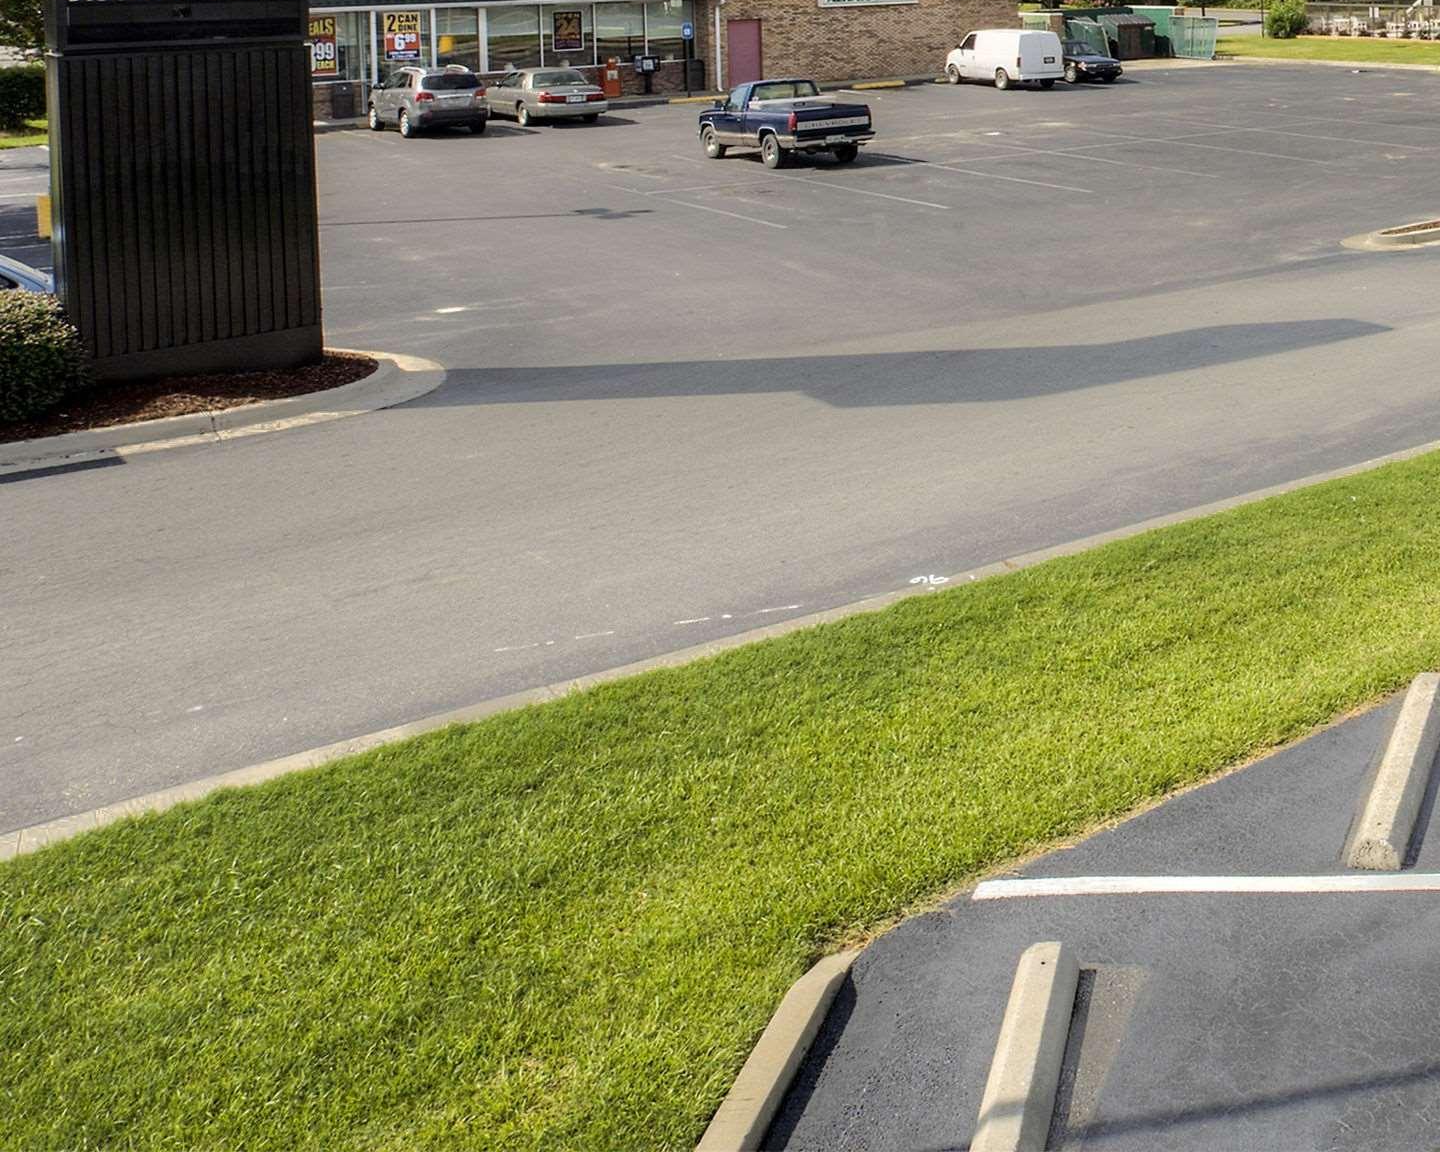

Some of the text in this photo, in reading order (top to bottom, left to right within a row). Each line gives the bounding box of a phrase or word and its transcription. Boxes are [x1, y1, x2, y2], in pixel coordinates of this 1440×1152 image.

[309, 18, 334, 36] EALS
[387, 14, 418, 32] 2 CAN
